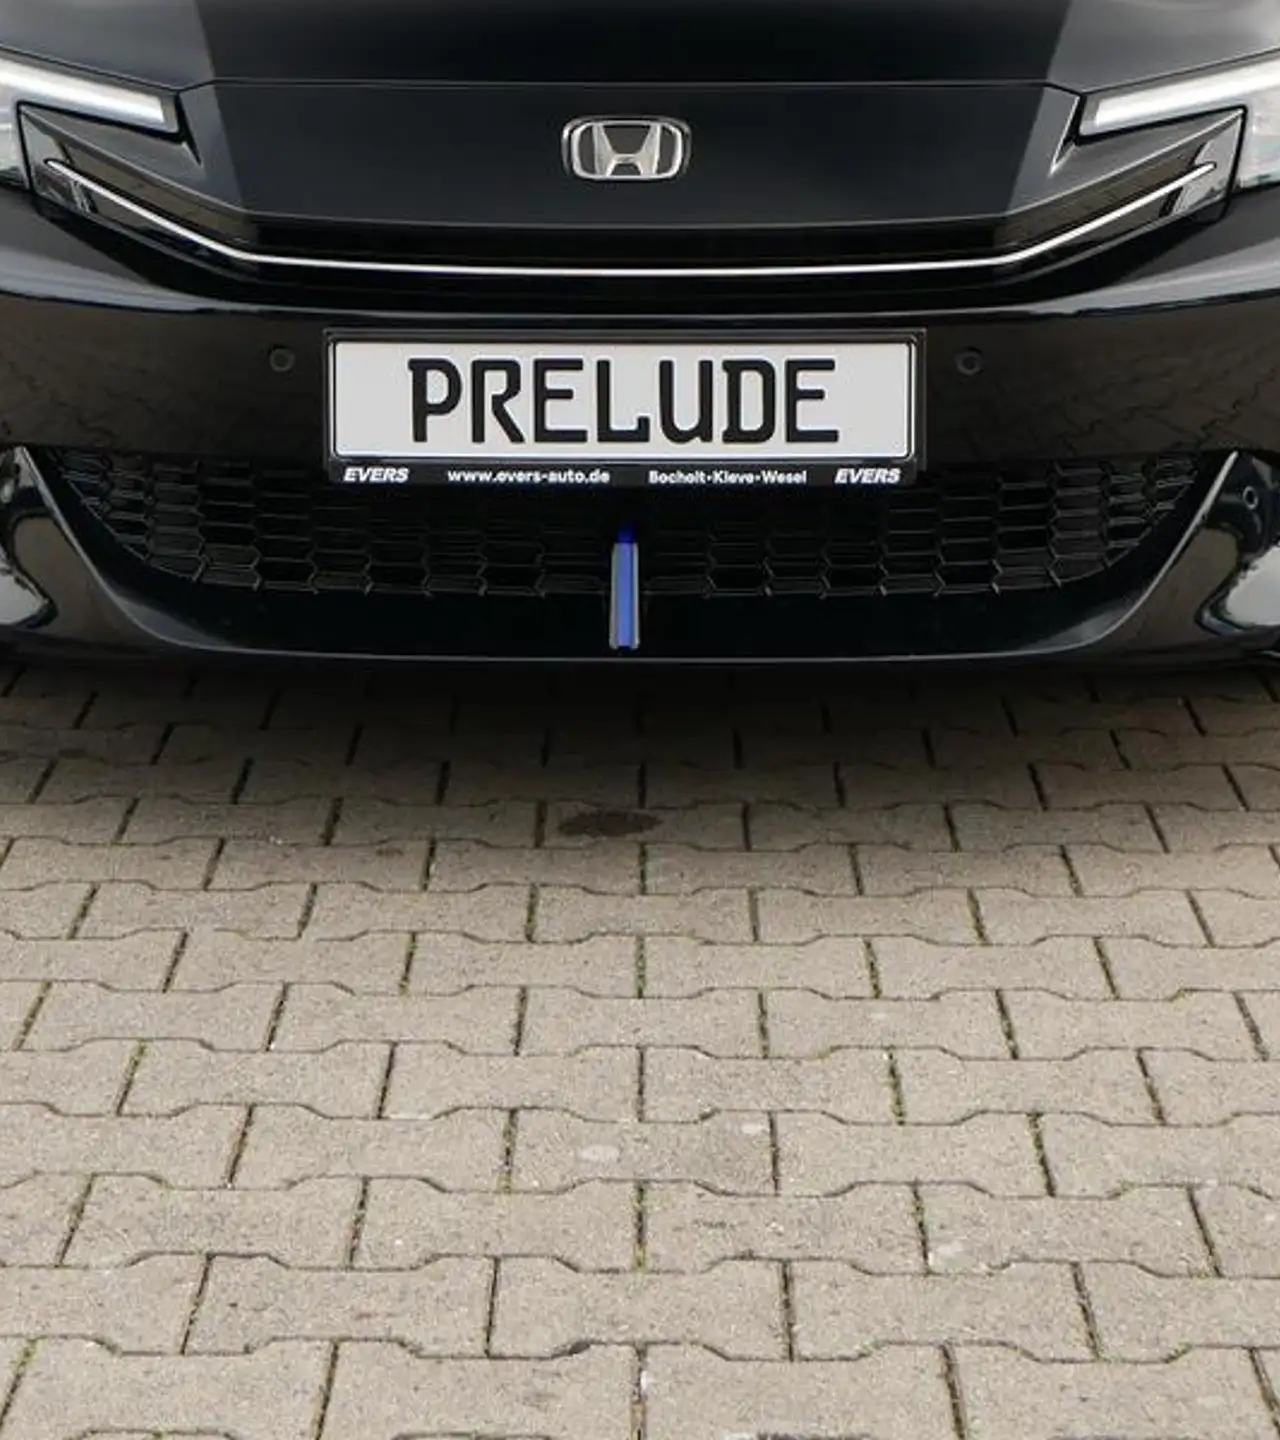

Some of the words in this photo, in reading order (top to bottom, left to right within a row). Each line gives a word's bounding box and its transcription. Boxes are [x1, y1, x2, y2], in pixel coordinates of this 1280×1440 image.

[408, 357, 839, 443] PRELUDE
[343, 467, 409, 483] EVERS
[447, 468, 611, 484] www.evers-auto.de
[835, 468, 900, 484] EVERS
